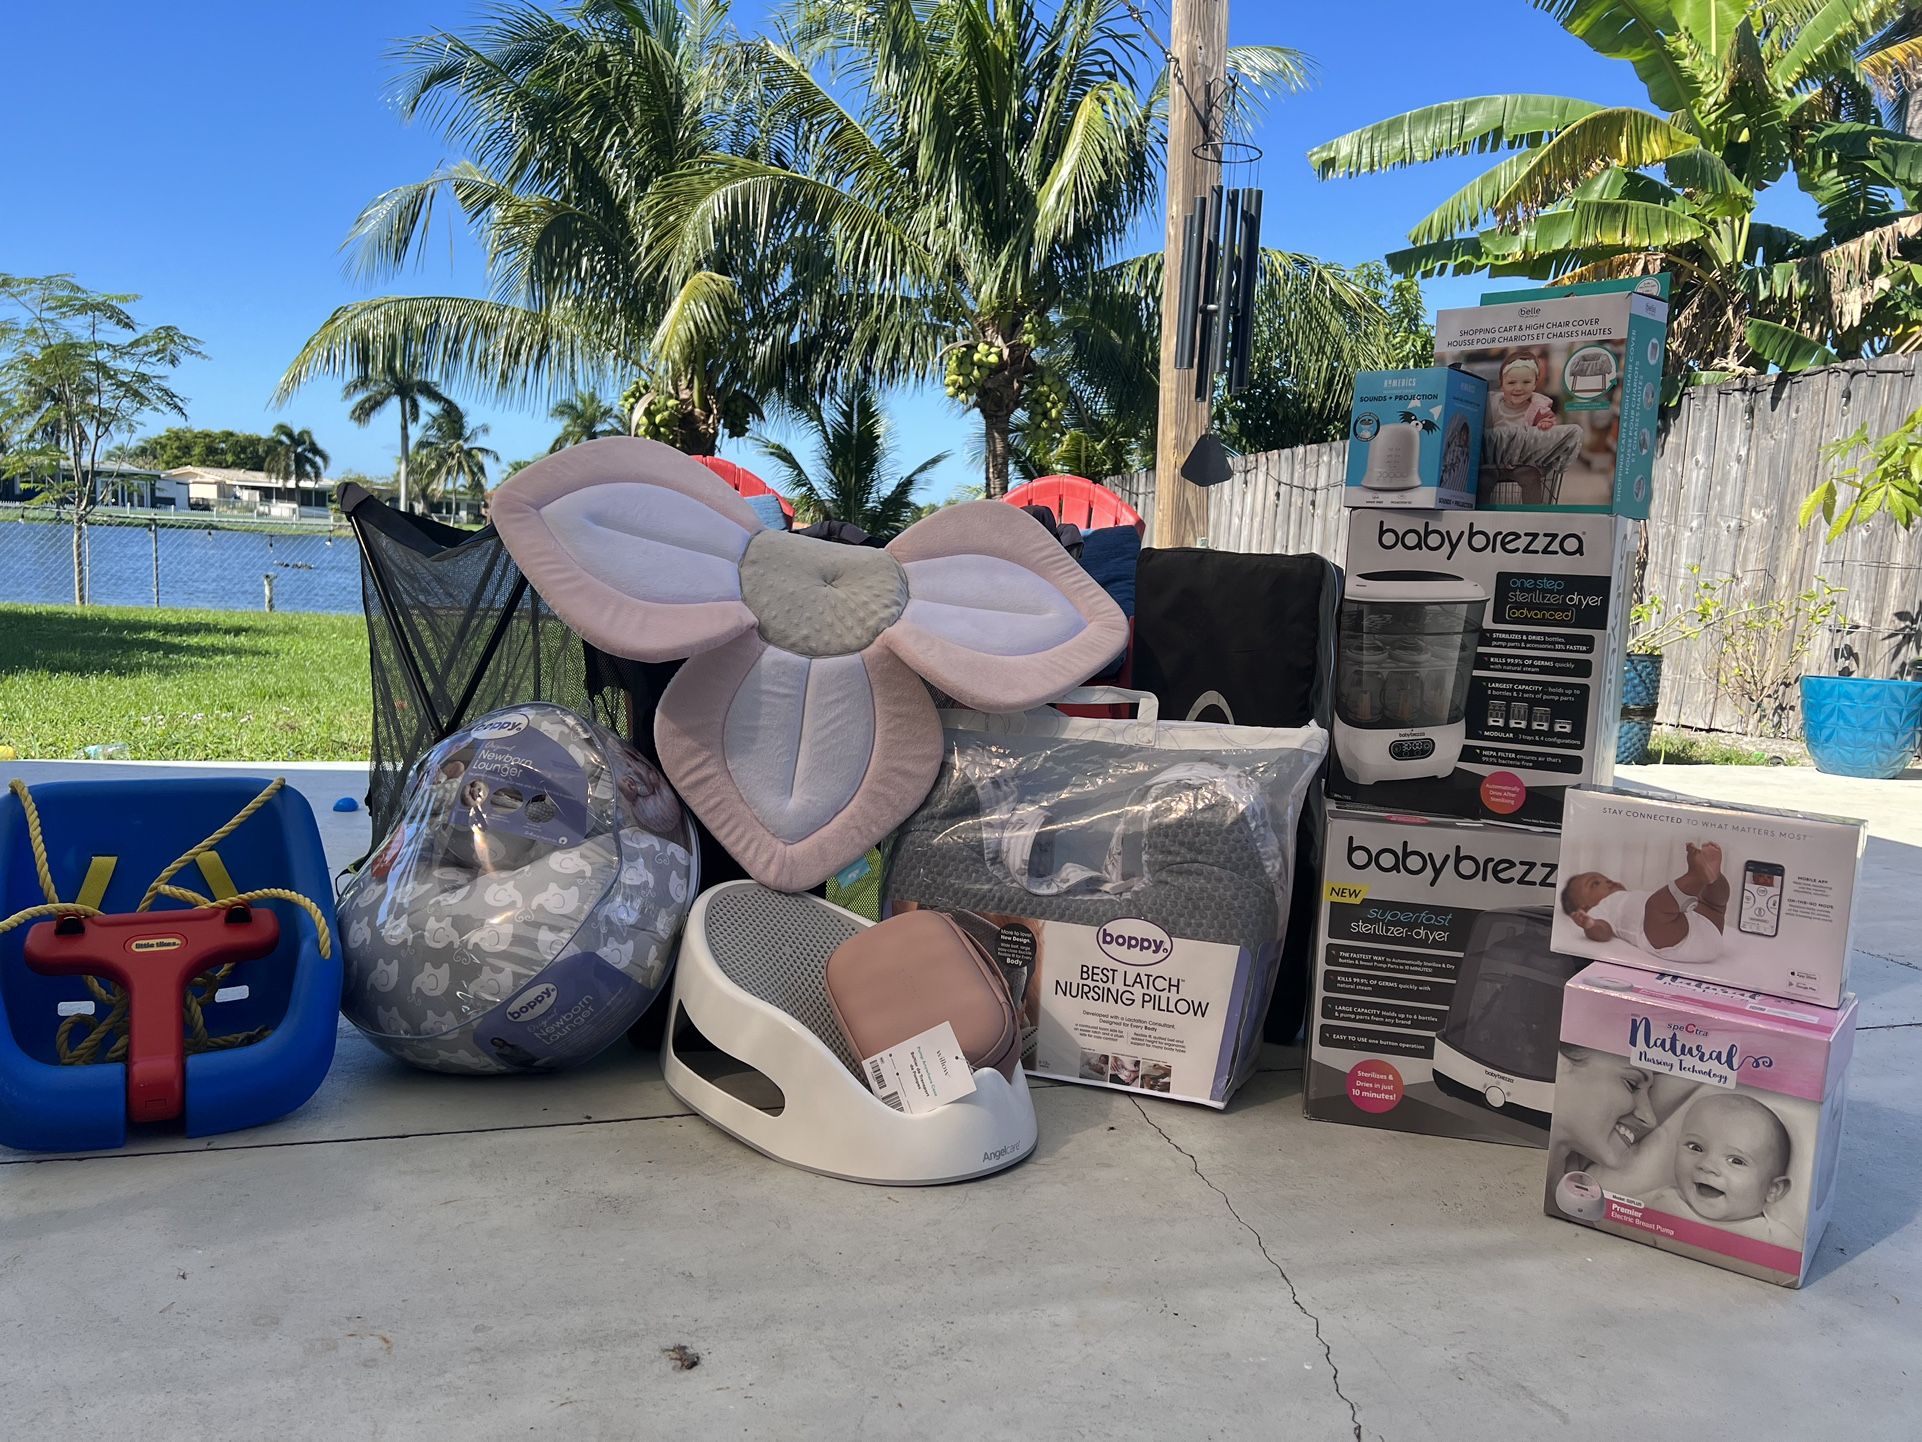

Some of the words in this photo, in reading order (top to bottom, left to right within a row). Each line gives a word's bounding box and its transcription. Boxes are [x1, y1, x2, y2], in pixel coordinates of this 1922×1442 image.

[1520, 307, 1541, 316] belle
[1459, 327, 1496, 336] SHOPPING
[1498, 325, 1517, 334] CART
[1525, 322, 1544, 330] HIGH
[1546, 320, 1570, 329] CHAIR
[1571, 318, 1600, 327] COVER
[1448, 338, 1475, 347] HOUSSE
[1476, 337, 1496, 345] POUR
[1498, 334, 1535, 343] CHARIOTS
[1547, 331, 1579, 339] CHAISES
[1581, 328, 1612, 337] HAUTES
[1628, 329, 1637, 362] COVER
[1625, 364, 1633, 393] CHAIR
[1622, 394, 1630, 420] HIGH
[1624, 438, 1632, 474] HOUSSE
[1630, 360, 1640, 406] CHARIOTS
[1620, 429, 1628, 452] CART
[1616, 453, 1625, 502] SHOPPING
[1509, 589, 1564, 604] sterilizer
[1566, 592, 1603, 609] dryer
[479, 750, 533, 767] Newborn
[472, 760, 523, 778] Lounger
[1602, 807, 1624, 816] STAY
[1625, 810, 1682, 824] CONNECTED
[1701, 820, 1728, 831] WHAT
[1732, 825, 1775, 837] MATTERS
[1779, 831, 1808, 841] MOST
[1330, 886, 1362, 899] NEW
[1368, 907, 1453, 927] superfast
[1350, 919, 1450, 944] sterilizer-dryer
[1007, 958, 1022, 966] Body
[1392, 958, 1423, 966] Automatically
[1080, 964, 1118, 985] BEST
[1055, 980, 1135, 1007] NURSING
[1142, 993, 1209, 1018] PILLOW
[534, 995, 593, 1038] Newborn
[1082, 1010, 1109, 1019] Developed
[1125, 1016, 1147, 1024] Lactation
[1354, 1007, 1380, 1015] CAPACITY
[542, 1006, 594, 1045] Lounger
[1099, 1018, 1122, 1026] Designed
[1399, 1042, 1425, 1050] operation
[1629, 1016, 1742, 1071] Natural
[936, 1050, 949, 1076] willow
[1638, 1051, 1674, 1072] Nursing
[1678, 1059, 1728, 1084] Technology
[1357, 1070, 1387, 1080] Sterilizes
[1352, 1088, 1360, 1096] 10
[1362, 1091, 1397, 1100] minutes!
[1356, 1080, 1373, 1088] Dries
[1382, 1083, 1393, 1091] just
[1612, 1203, 1642, 1217] Premier
[1611, 1212, 1634, 1223] Electric
[1635, 1218, 1655, 1230] Breast
[1656, 1224, 1674, 1236] Pump
